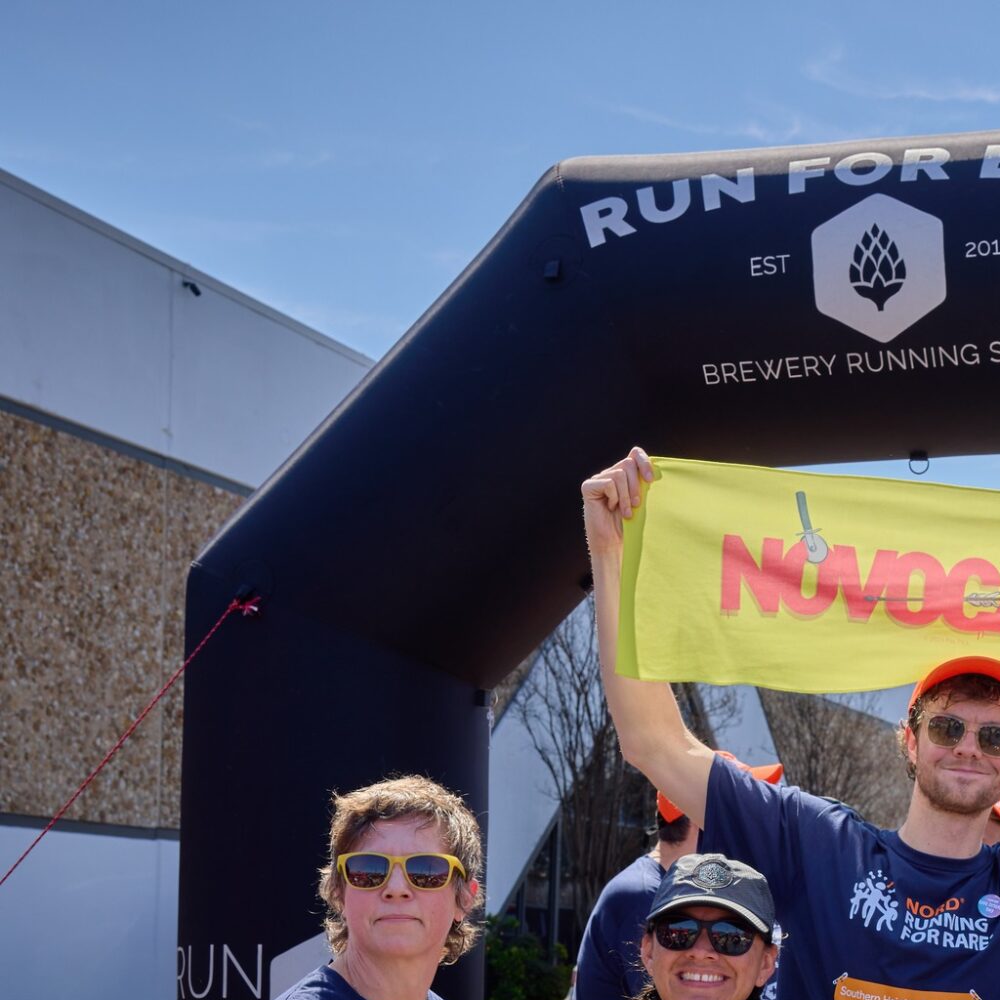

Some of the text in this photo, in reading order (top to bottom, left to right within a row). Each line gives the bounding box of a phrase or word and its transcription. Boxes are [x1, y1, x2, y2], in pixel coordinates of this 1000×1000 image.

[580, 167, 755, 248] RUN
[788, 148, 951, 195] FOR
[750, 254, 791, 276] EST
[702, 354, 837, 385] BREWERY
[847, 344, 981, 374] RUNNING
[905, 911, 989, 933] RUNNING
[900, 925, 940, 945] FOR
